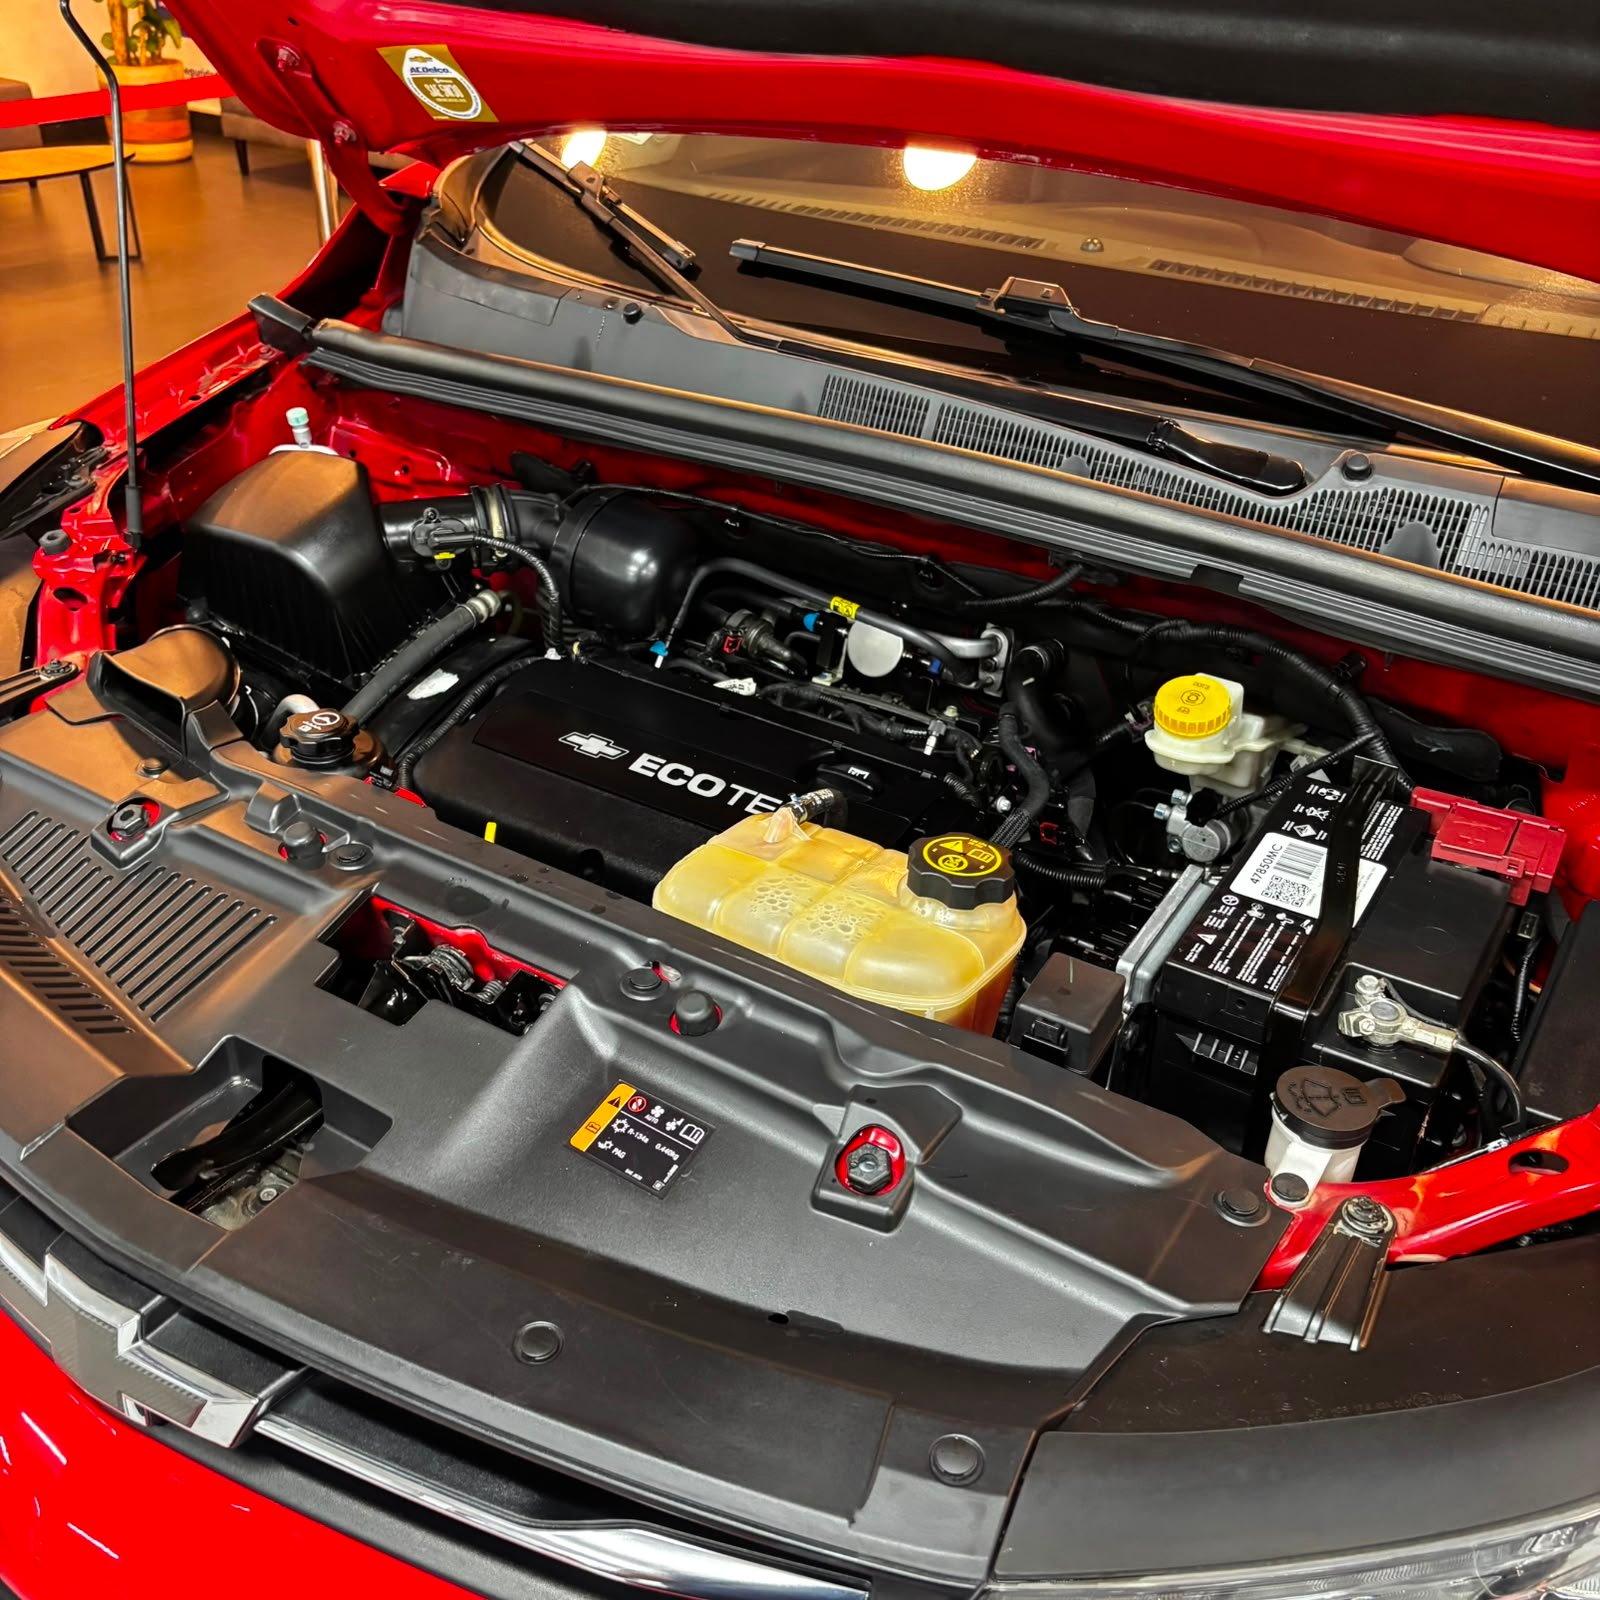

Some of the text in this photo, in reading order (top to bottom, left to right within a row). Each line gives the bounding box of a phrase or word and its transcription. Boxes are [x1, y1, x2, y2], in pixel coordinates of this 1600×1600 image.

[410, 66, 449, 74] ACDelco
[628, 752, 783, 815] ECOTE
[1250, 843, 1283, 885] 47850MC
[644, 1113, 660, 1124] AUTO
[627, 1128, 650, 1144] R-134a
[611, 1147, 626, 1159] PAG
